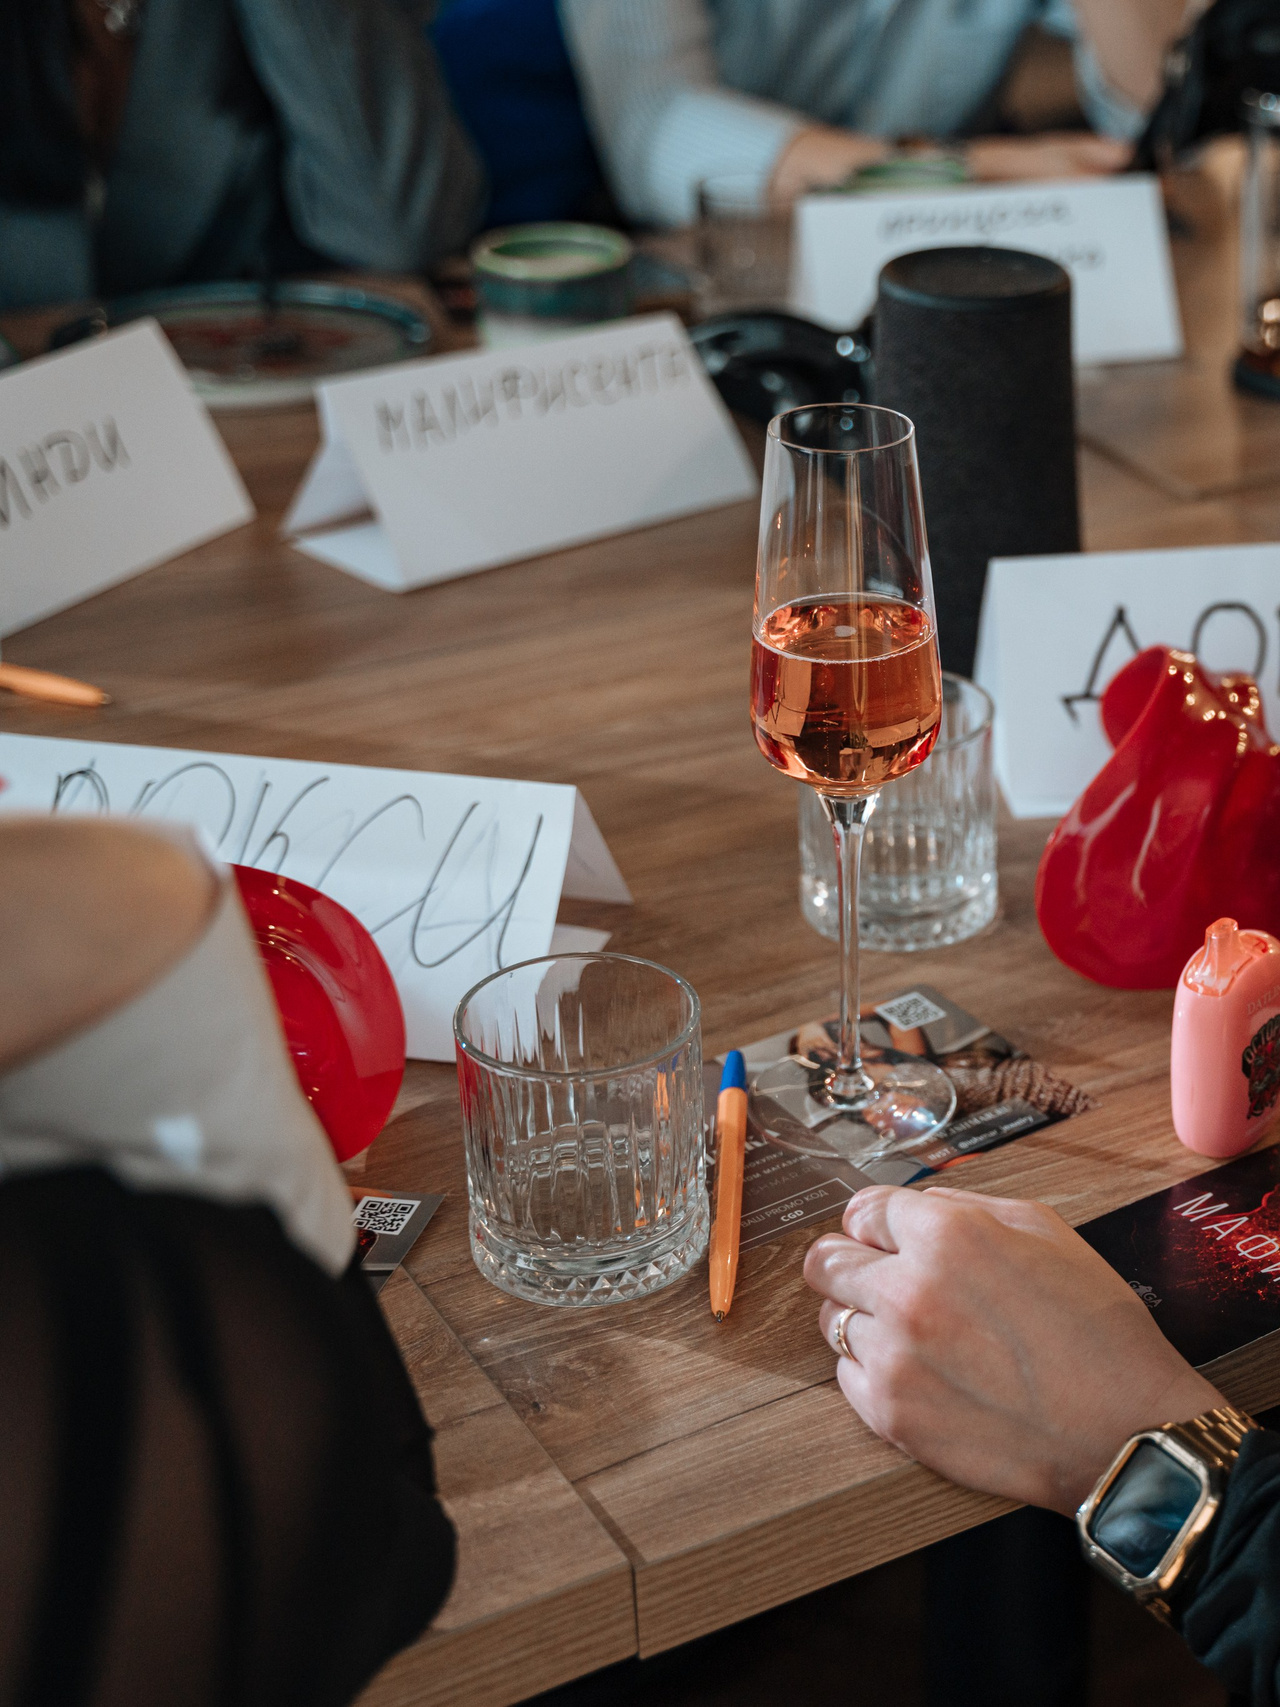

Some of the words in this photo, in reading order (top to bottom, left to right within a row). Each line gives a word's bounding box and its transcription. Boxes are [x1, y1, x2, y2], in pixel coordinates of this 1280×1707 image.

[741, 1213, 766, 1228] ВАШ
[765, 1198, 804, 1218] PROMO
[803, 1188, 830, 1202] КОД
[780, 1209, 805, 1222] CGD
